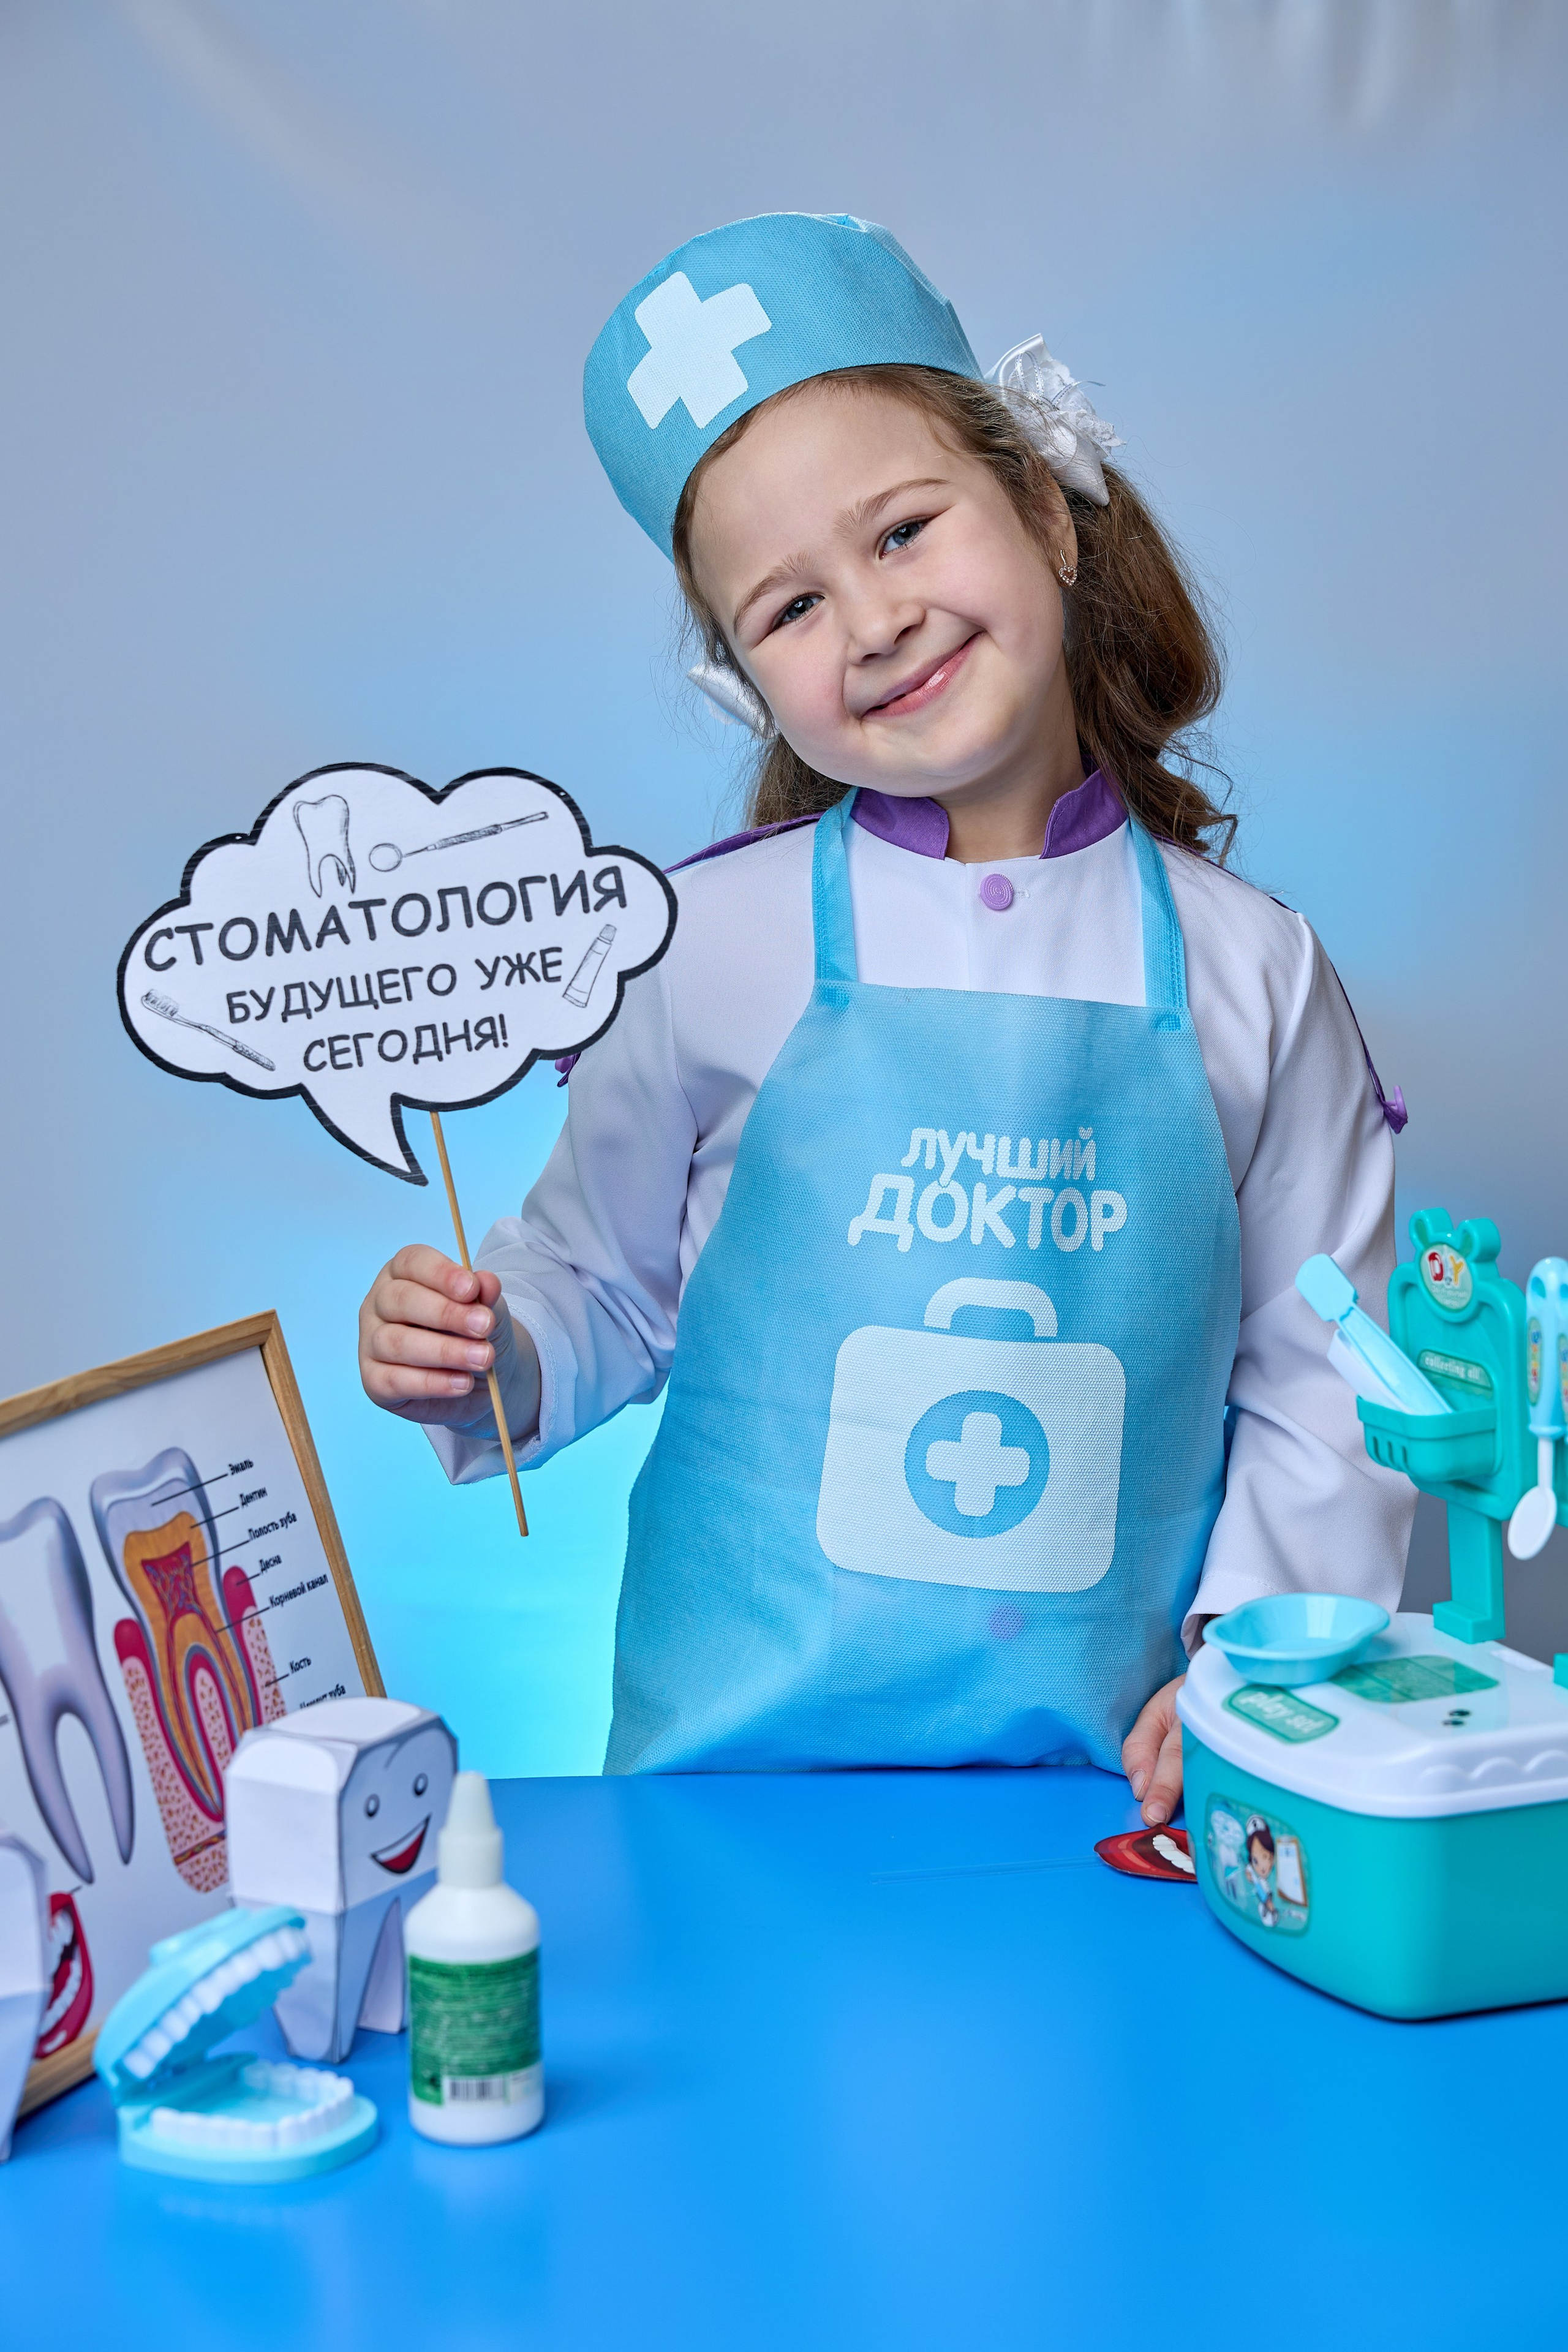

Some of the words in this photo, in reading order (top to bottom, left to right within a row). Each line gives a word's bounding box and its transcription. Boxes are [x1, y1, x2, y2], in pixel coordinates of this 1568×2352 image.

[143, 865, 627, 972] СТОМАТОЛОГИЯ
[226, 963, 457, 1025] БУДУЩЕГО
[474, 947, 564, 990] УЖЕ
[303, 1014, 509, 1072] СЕГОДНЯ!
[847, 1172, 1128, 1253] ДОКТОР
[228, 1458, 254, 1476] Эмаль
[239, 1487, 268, 1509] Дентин
[248, 1520, 279, 1541] Полость
[279, 1511, 298, 1529] зуба
[259, 1555, 282, 1575] Десна
[269, 1581, 307, 1608] Корневой
[306, 1574, 329, 1591] канал
[290, 1657, 312, 1674] Кость
